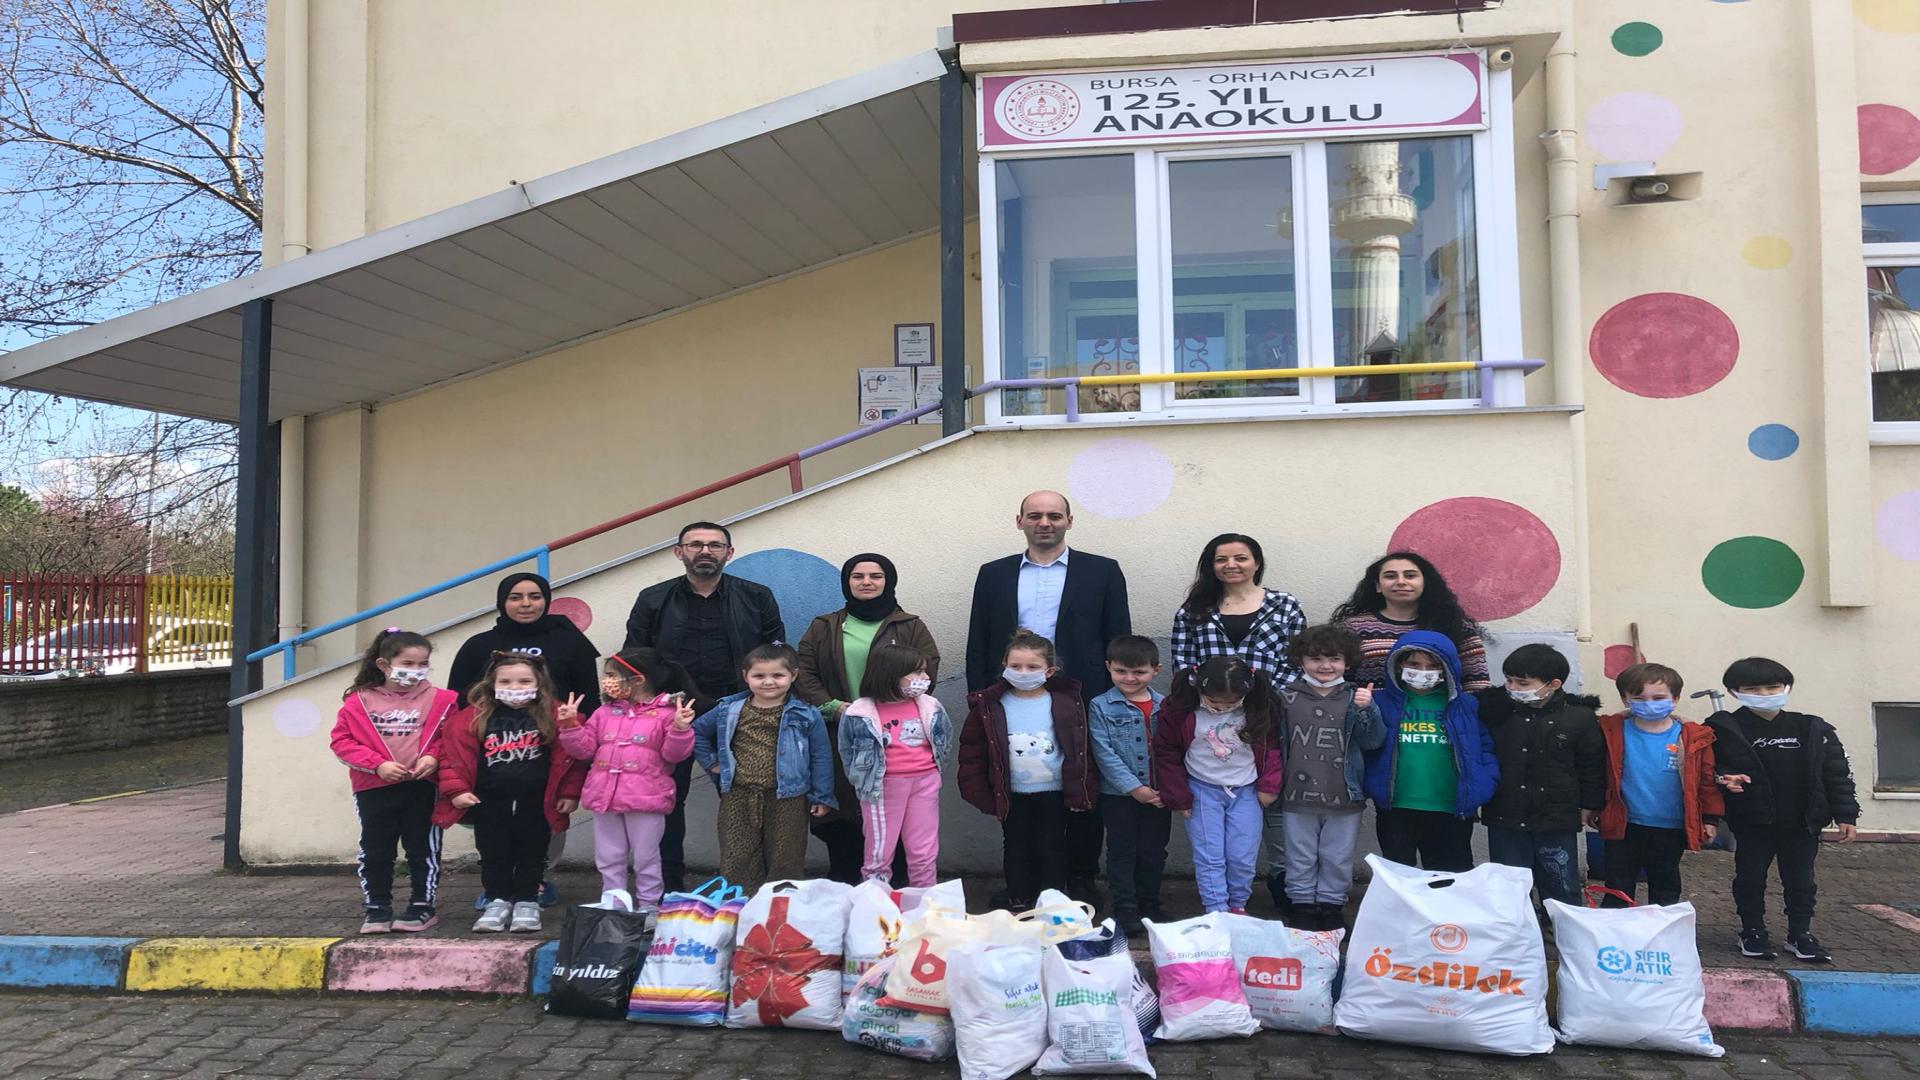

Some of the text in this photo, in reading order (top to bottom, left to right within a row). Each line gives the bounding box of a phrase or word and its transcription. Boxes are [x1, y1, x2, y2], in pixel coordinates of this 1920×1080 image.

[1090, 76, 1178, 90] BURSA
[1208, 65, 1376, 85] ORHANGAZİ
[1096, 87, 1285, 111] 125. YIL
[1092, 103, 1383, 133] ANAOKULU
[1248, 967, 1299, 986] tedi
[1365, 946, 1526, 996] Özdilek
[1635, 962, 1673, 976] ATIK
